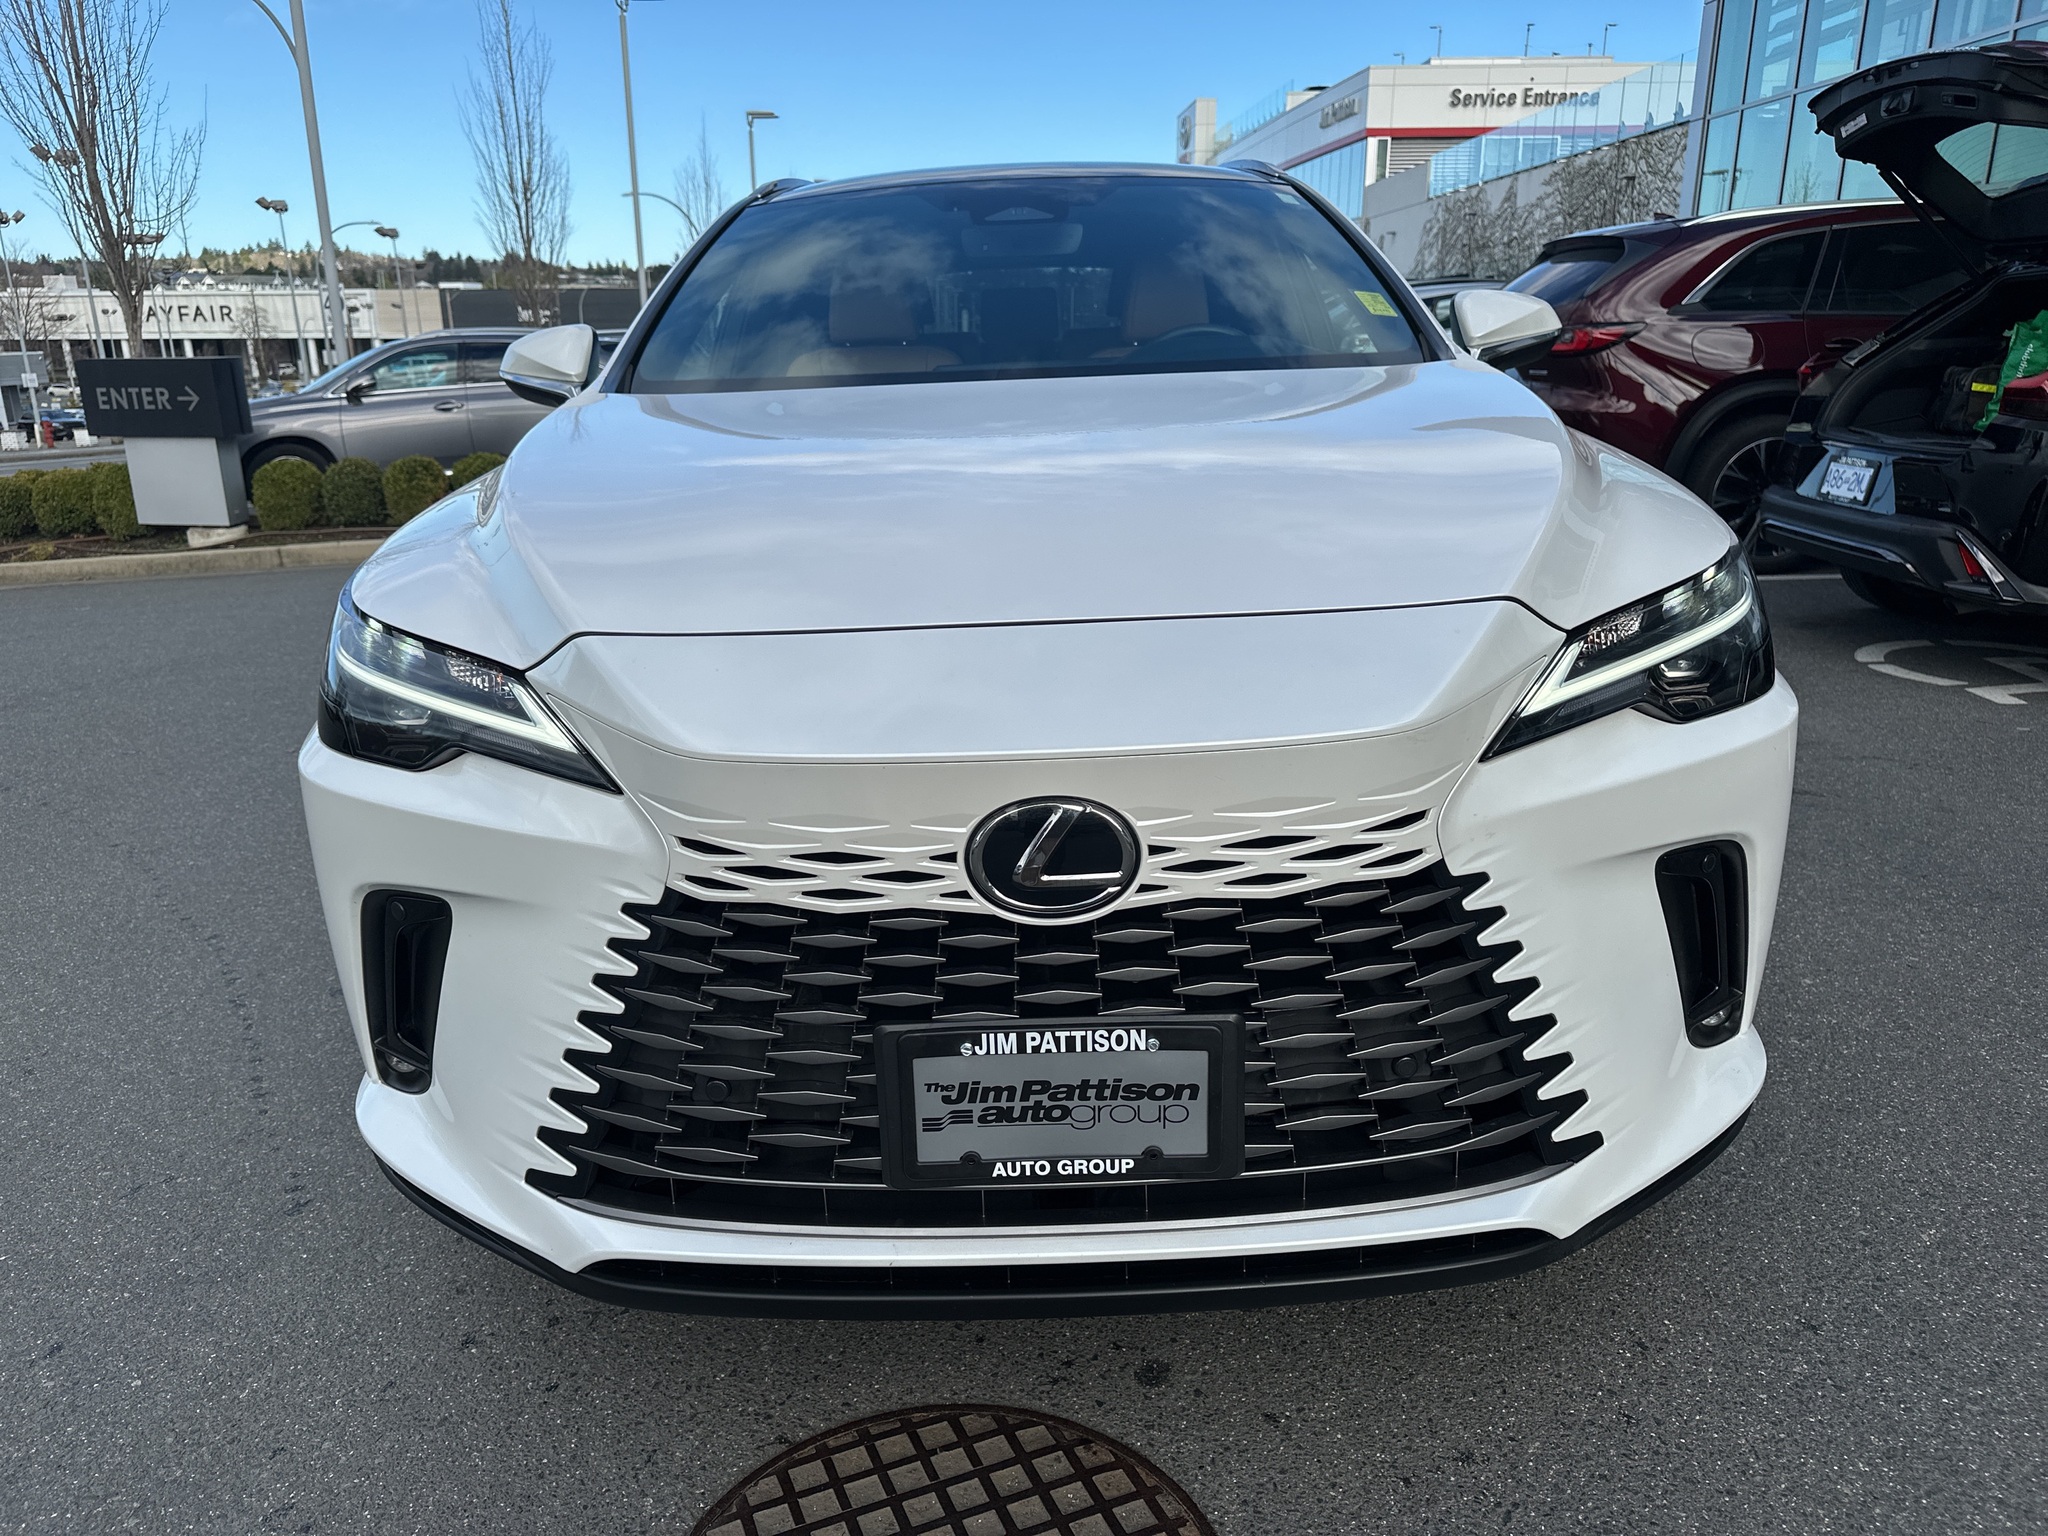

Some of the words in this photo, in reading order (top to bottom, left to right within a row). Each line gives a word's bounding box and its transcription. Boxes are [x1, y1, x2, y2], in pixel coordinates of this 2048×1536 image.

[1449, 88, 1517, 108] Service
[1522, 87, 1600, 107] Entrance
[145, 305, 234, 322] AYFAIR
[95, 387, 172, 410] ENTER
[974, 1032, 1018, 1055] JIM
[1025, 1029, 1147, 1053] PATTISON
[924, 1082, 956, 1093] The
[992, 1160, 1051, 1177] AUTO
[1057, 1158, 1135, 1175] GROUP
